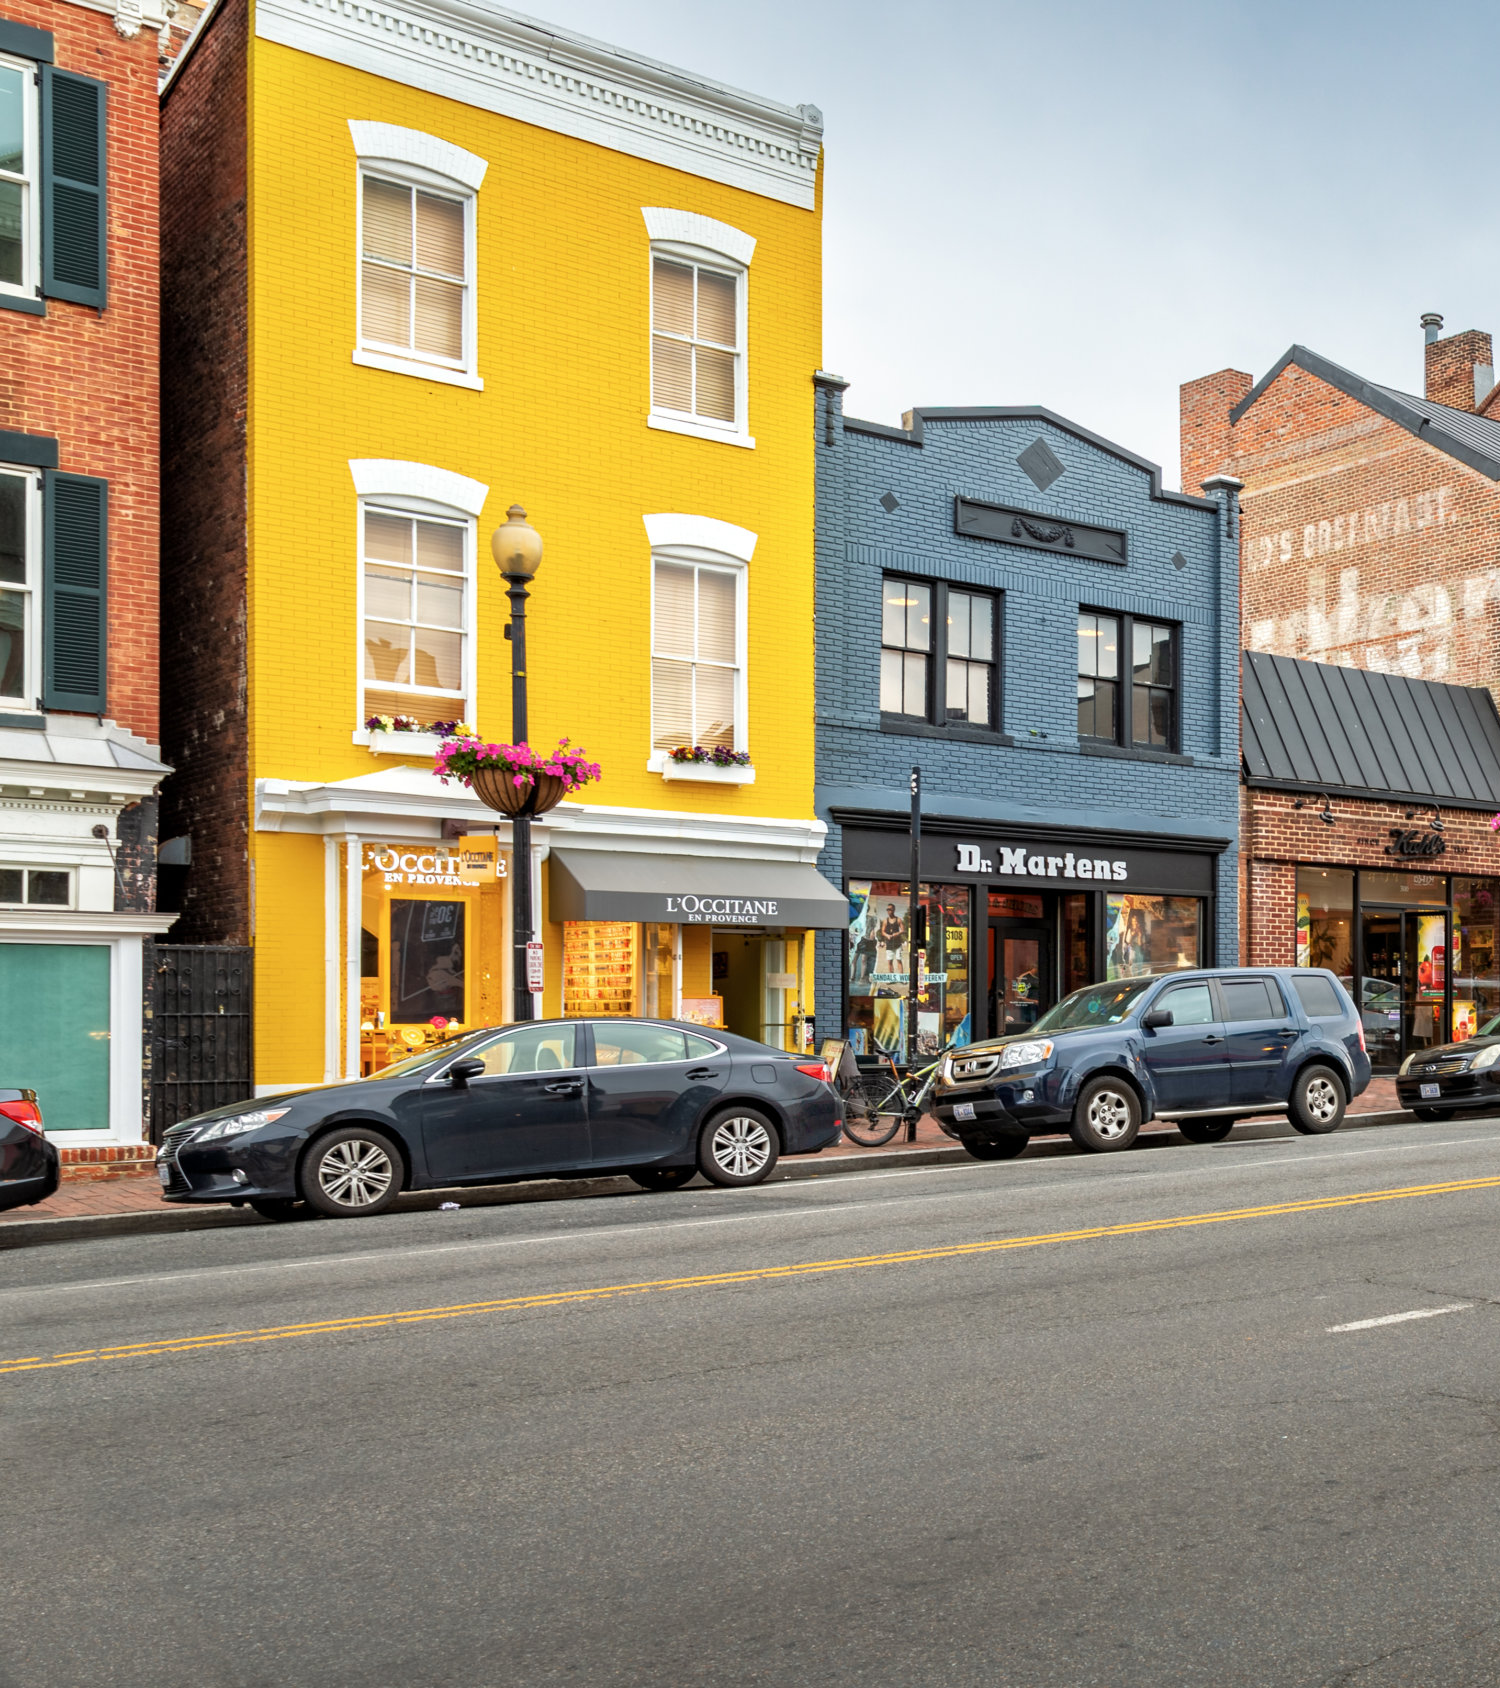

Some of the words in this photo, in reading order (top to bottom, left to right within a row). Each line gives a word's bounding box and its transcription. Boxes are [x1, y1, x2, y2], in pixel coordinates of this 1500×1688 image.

[956, 844, 993, 873] Dr.
[999, 847, 1128, 881] Martens
[384, 873, 403, 883] EN
[666, 895, 779, 915] L'OCCITANE
[688, 914, 702, 922] EN
[705, 914, 758, 923] PROVENCE
[946, 930, 963, 940] 3108
